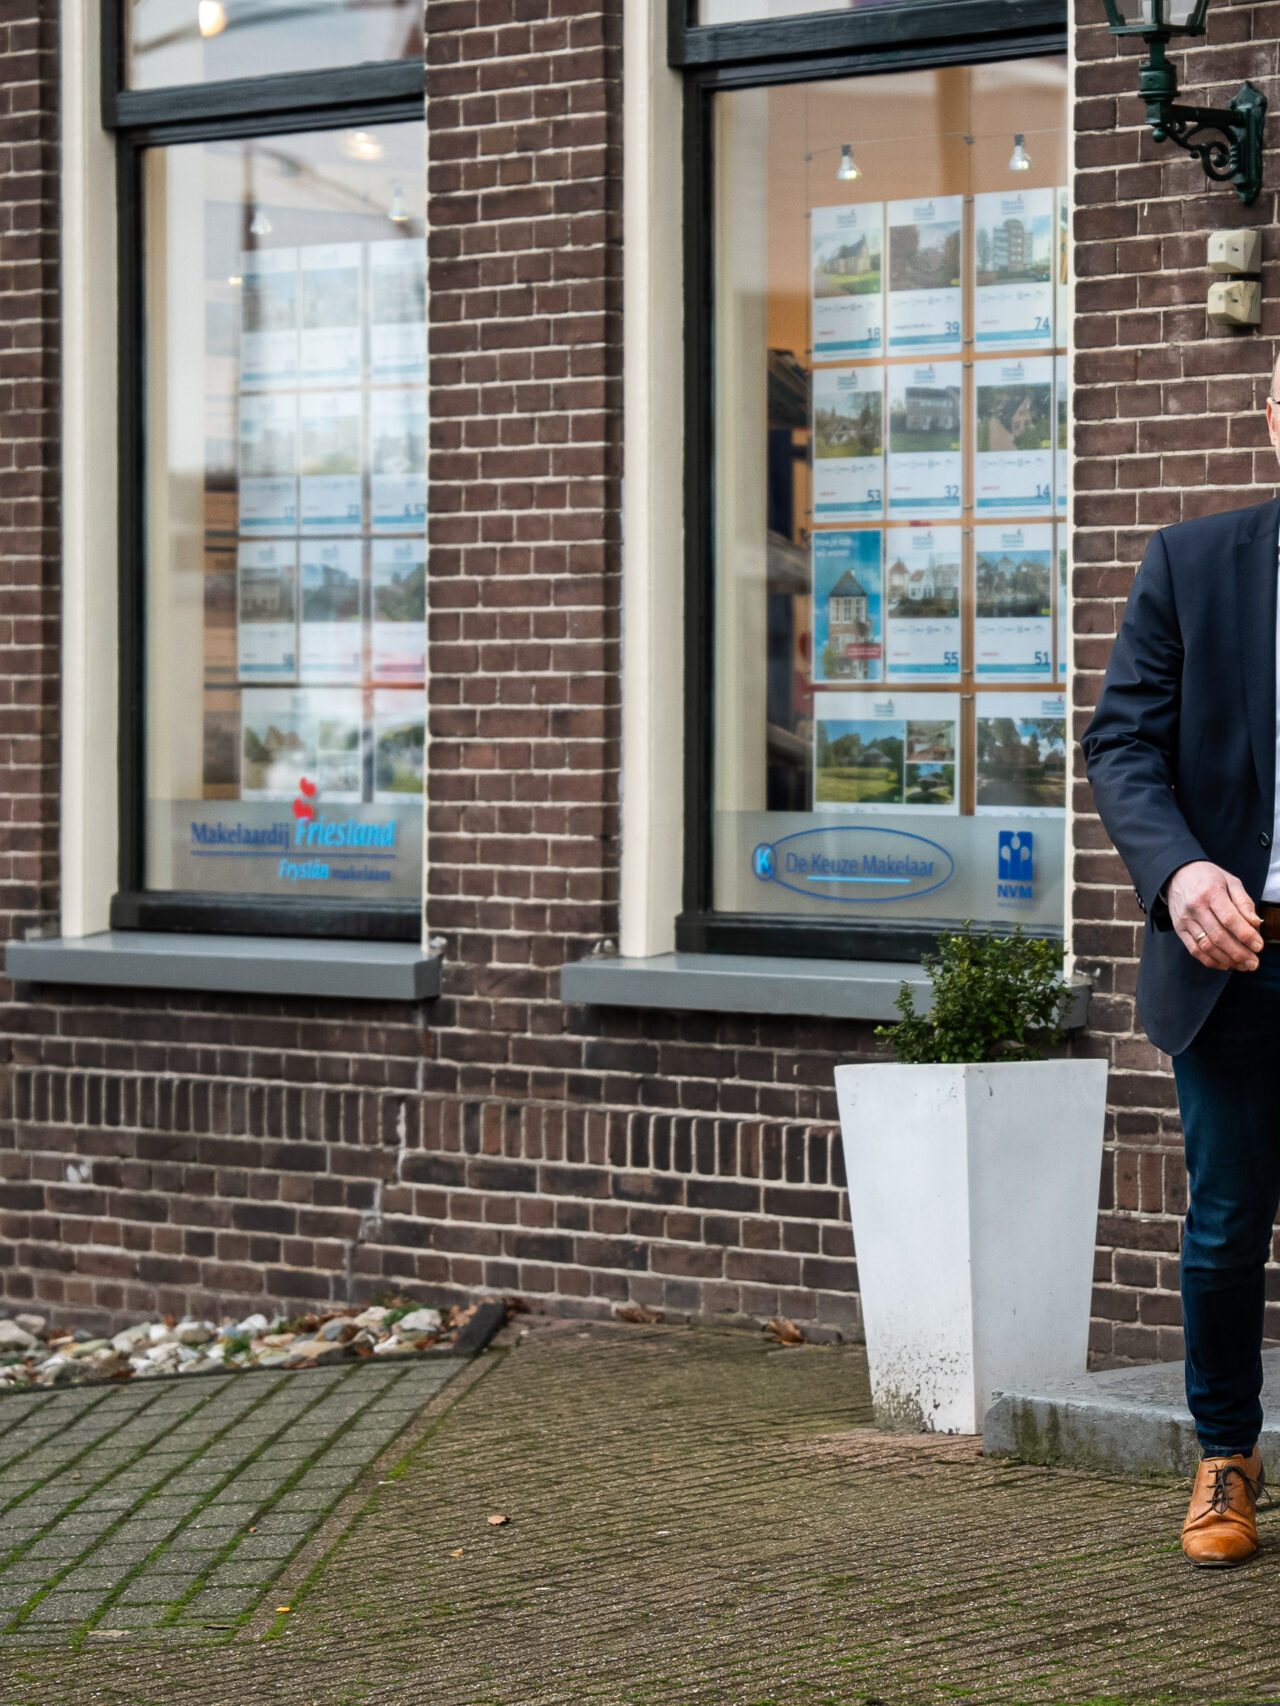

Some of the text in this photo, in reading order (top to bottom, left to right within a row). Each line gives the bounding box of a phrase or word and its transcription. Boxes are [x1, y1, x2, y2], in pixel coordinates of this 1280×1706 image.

[944, 320, 960, 337] 39
[1034, 316, 1051, 332] 74
[867, 327, 881, 342] 18
[867, 489, 882, 503] 53
[944, 484, 960, 500] 32
[1035, 484, 1051, 498] 14
[943, 651, 959, 666] 55
[1034, 651, 1050, 665] 51
[191, 816, 396, 849] Makelaardij Friesland
[756, 848, 773, 875] K
[786, 852, 935, 877] De Keuze Makelaar
[997, 884, 1033, 899] NVM
